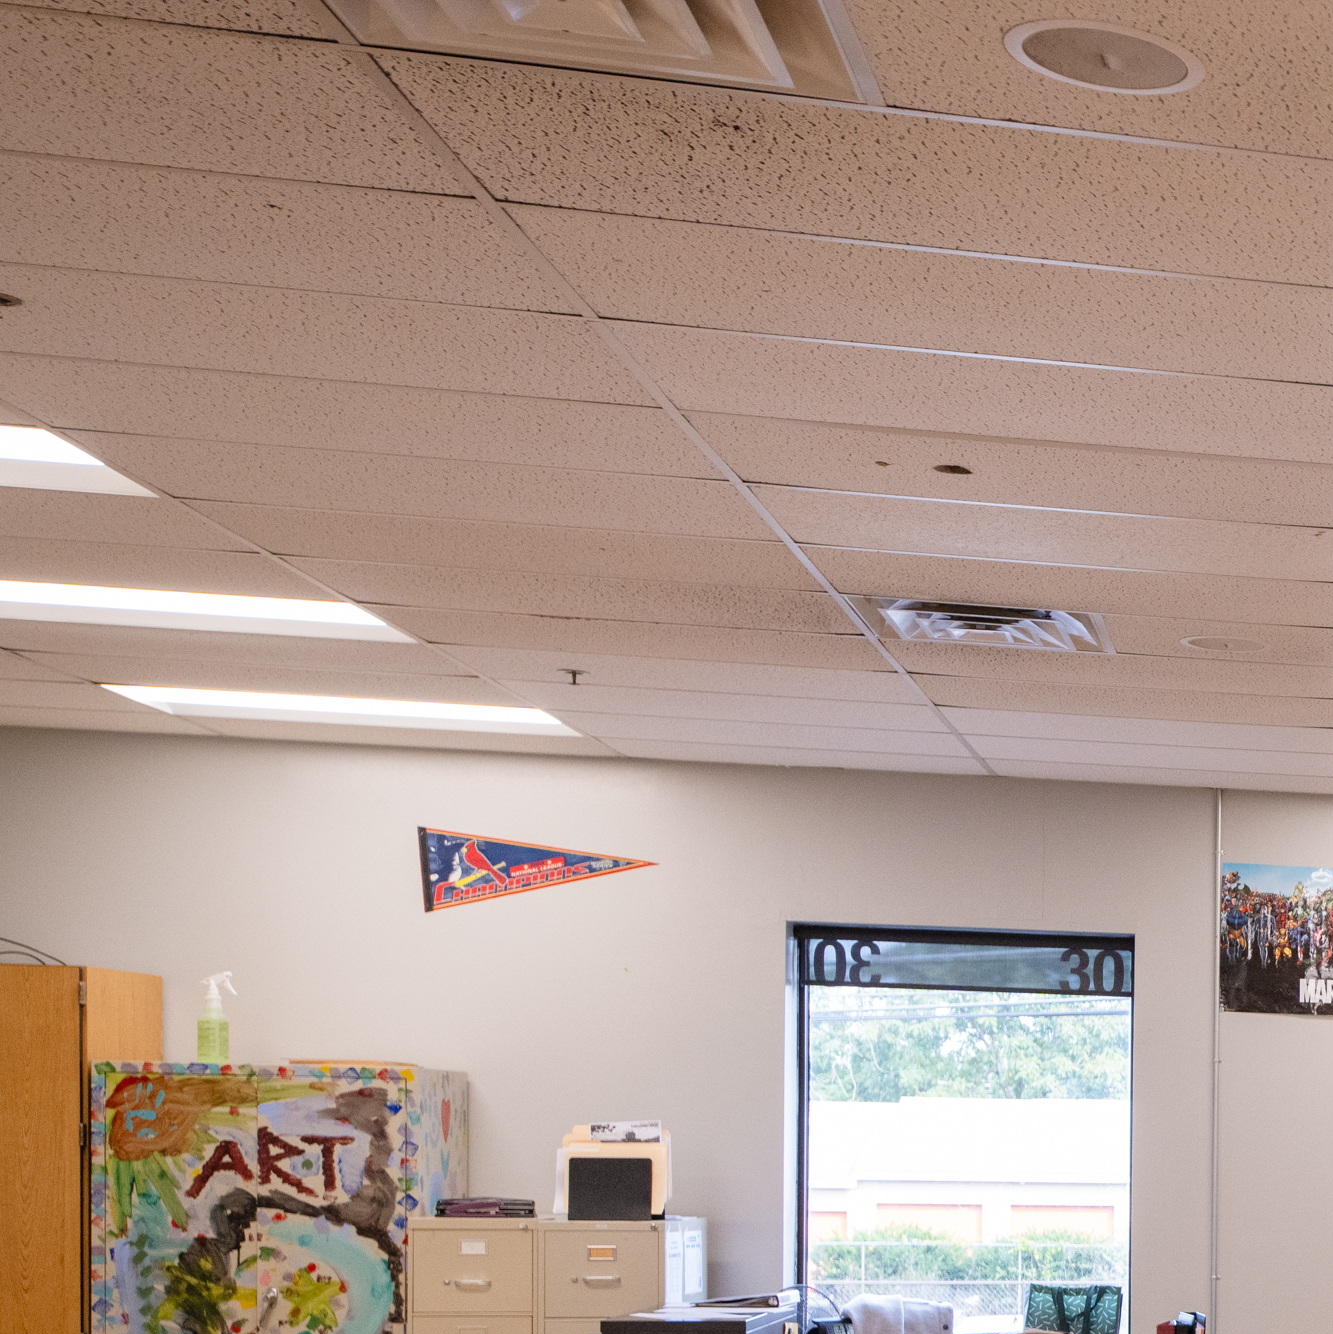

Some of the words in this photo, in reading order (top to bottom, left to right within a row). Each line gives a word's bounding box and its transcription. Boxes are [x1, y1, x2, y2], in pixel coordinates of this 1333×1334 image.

[511, 866, 539, 877] NATIONAL
[540, 861, 563, 871] LEAGUE
[1059, 946, 1125, 993] 30
[185, 1125, 355, 1199] ART
